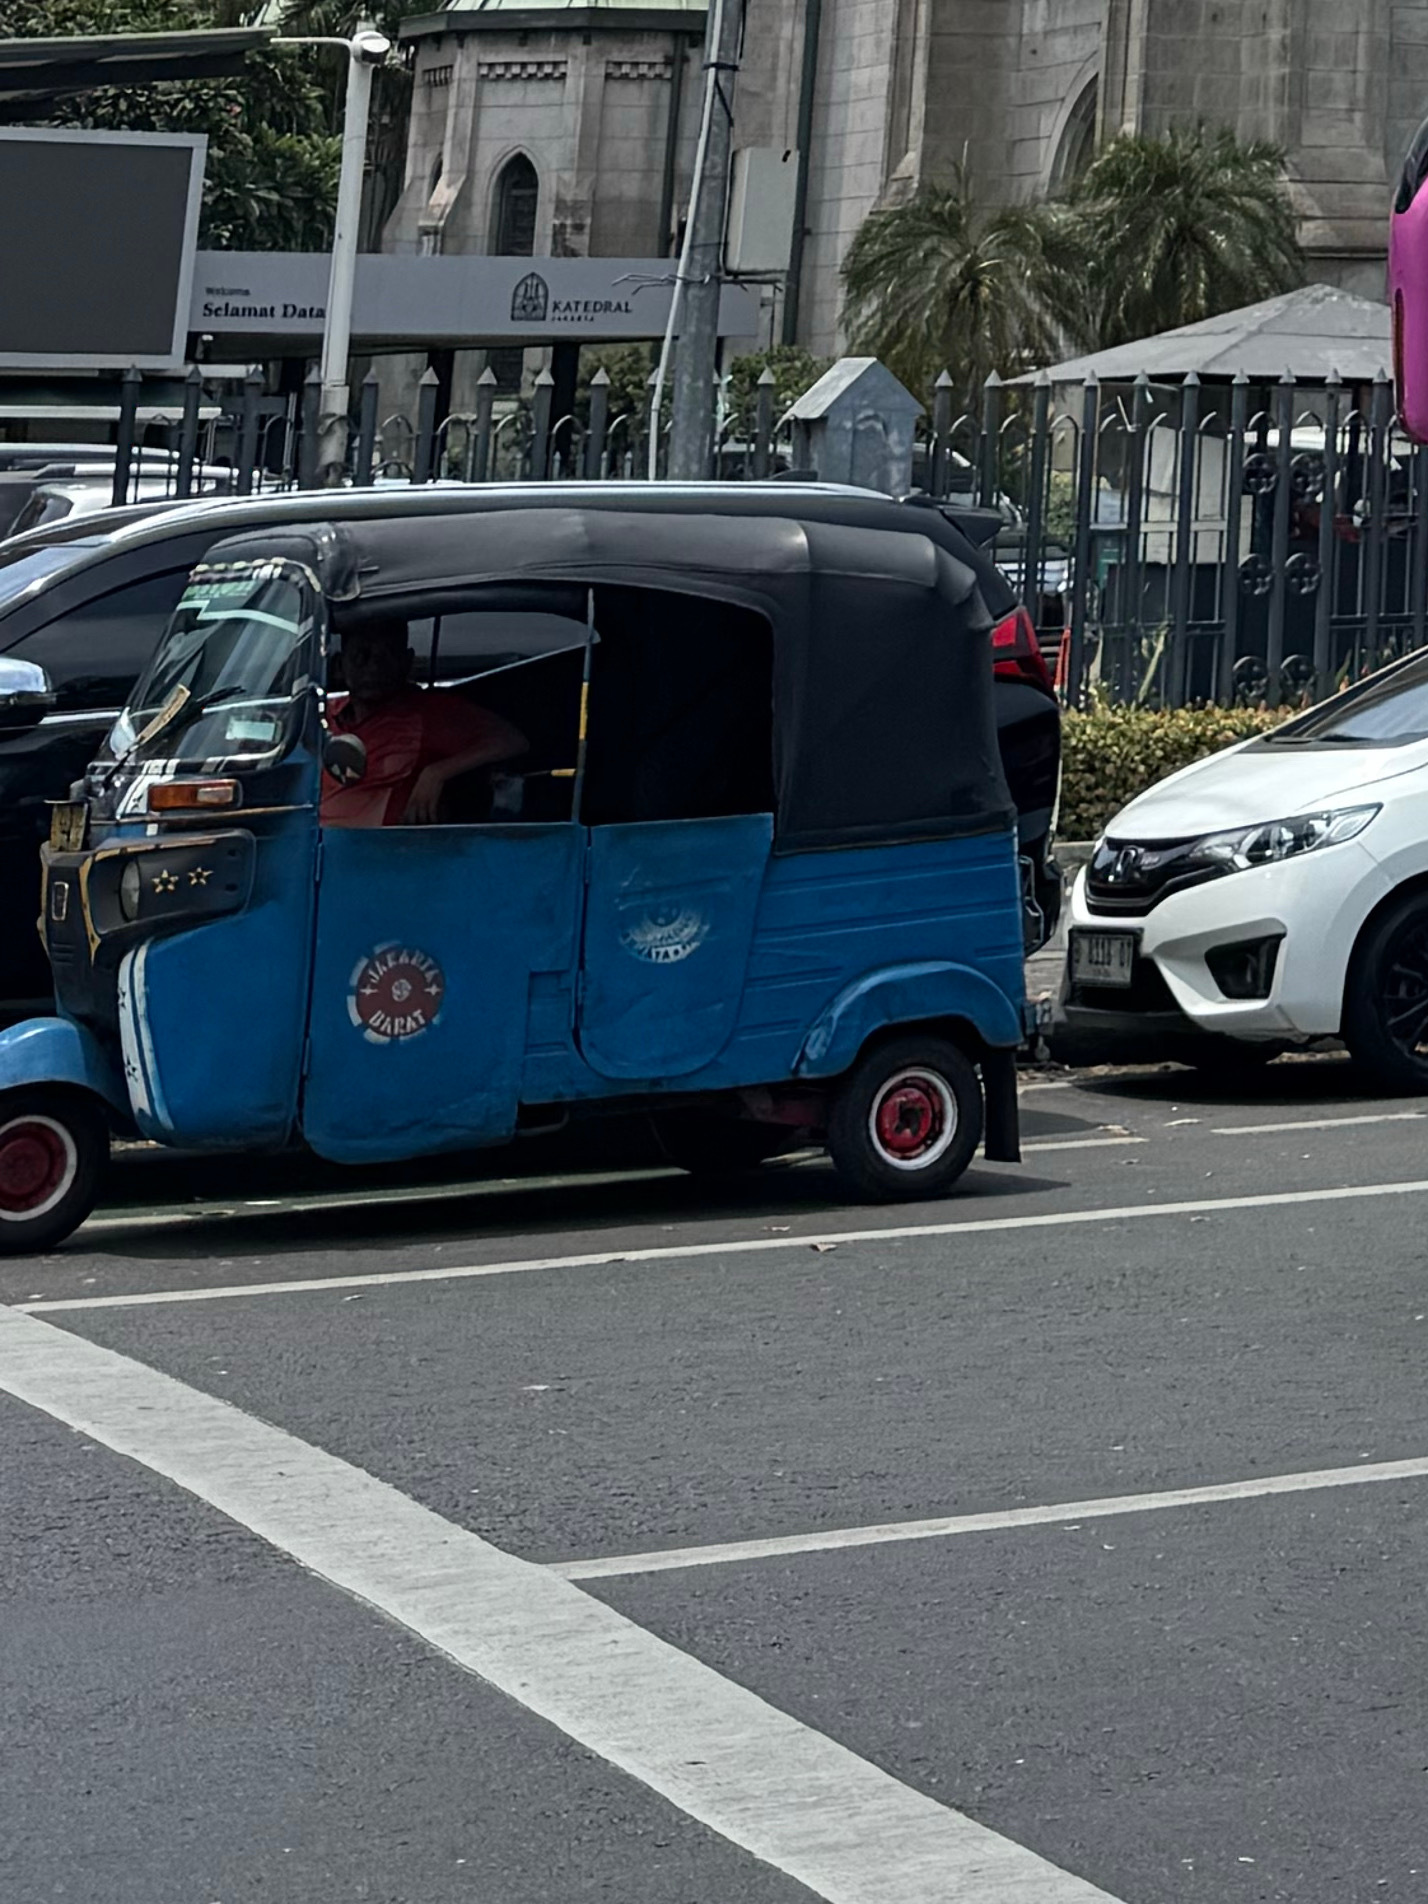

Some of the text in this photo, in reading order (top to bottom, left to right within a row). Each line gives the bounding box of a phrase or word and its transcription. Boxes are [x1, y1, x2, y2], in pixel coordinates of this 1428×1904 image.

[203, 302, 275, 318] Selamat
[552, 300, 632, 313] KATEDRAL
[368, 1009, 425, 1035] BARAT
